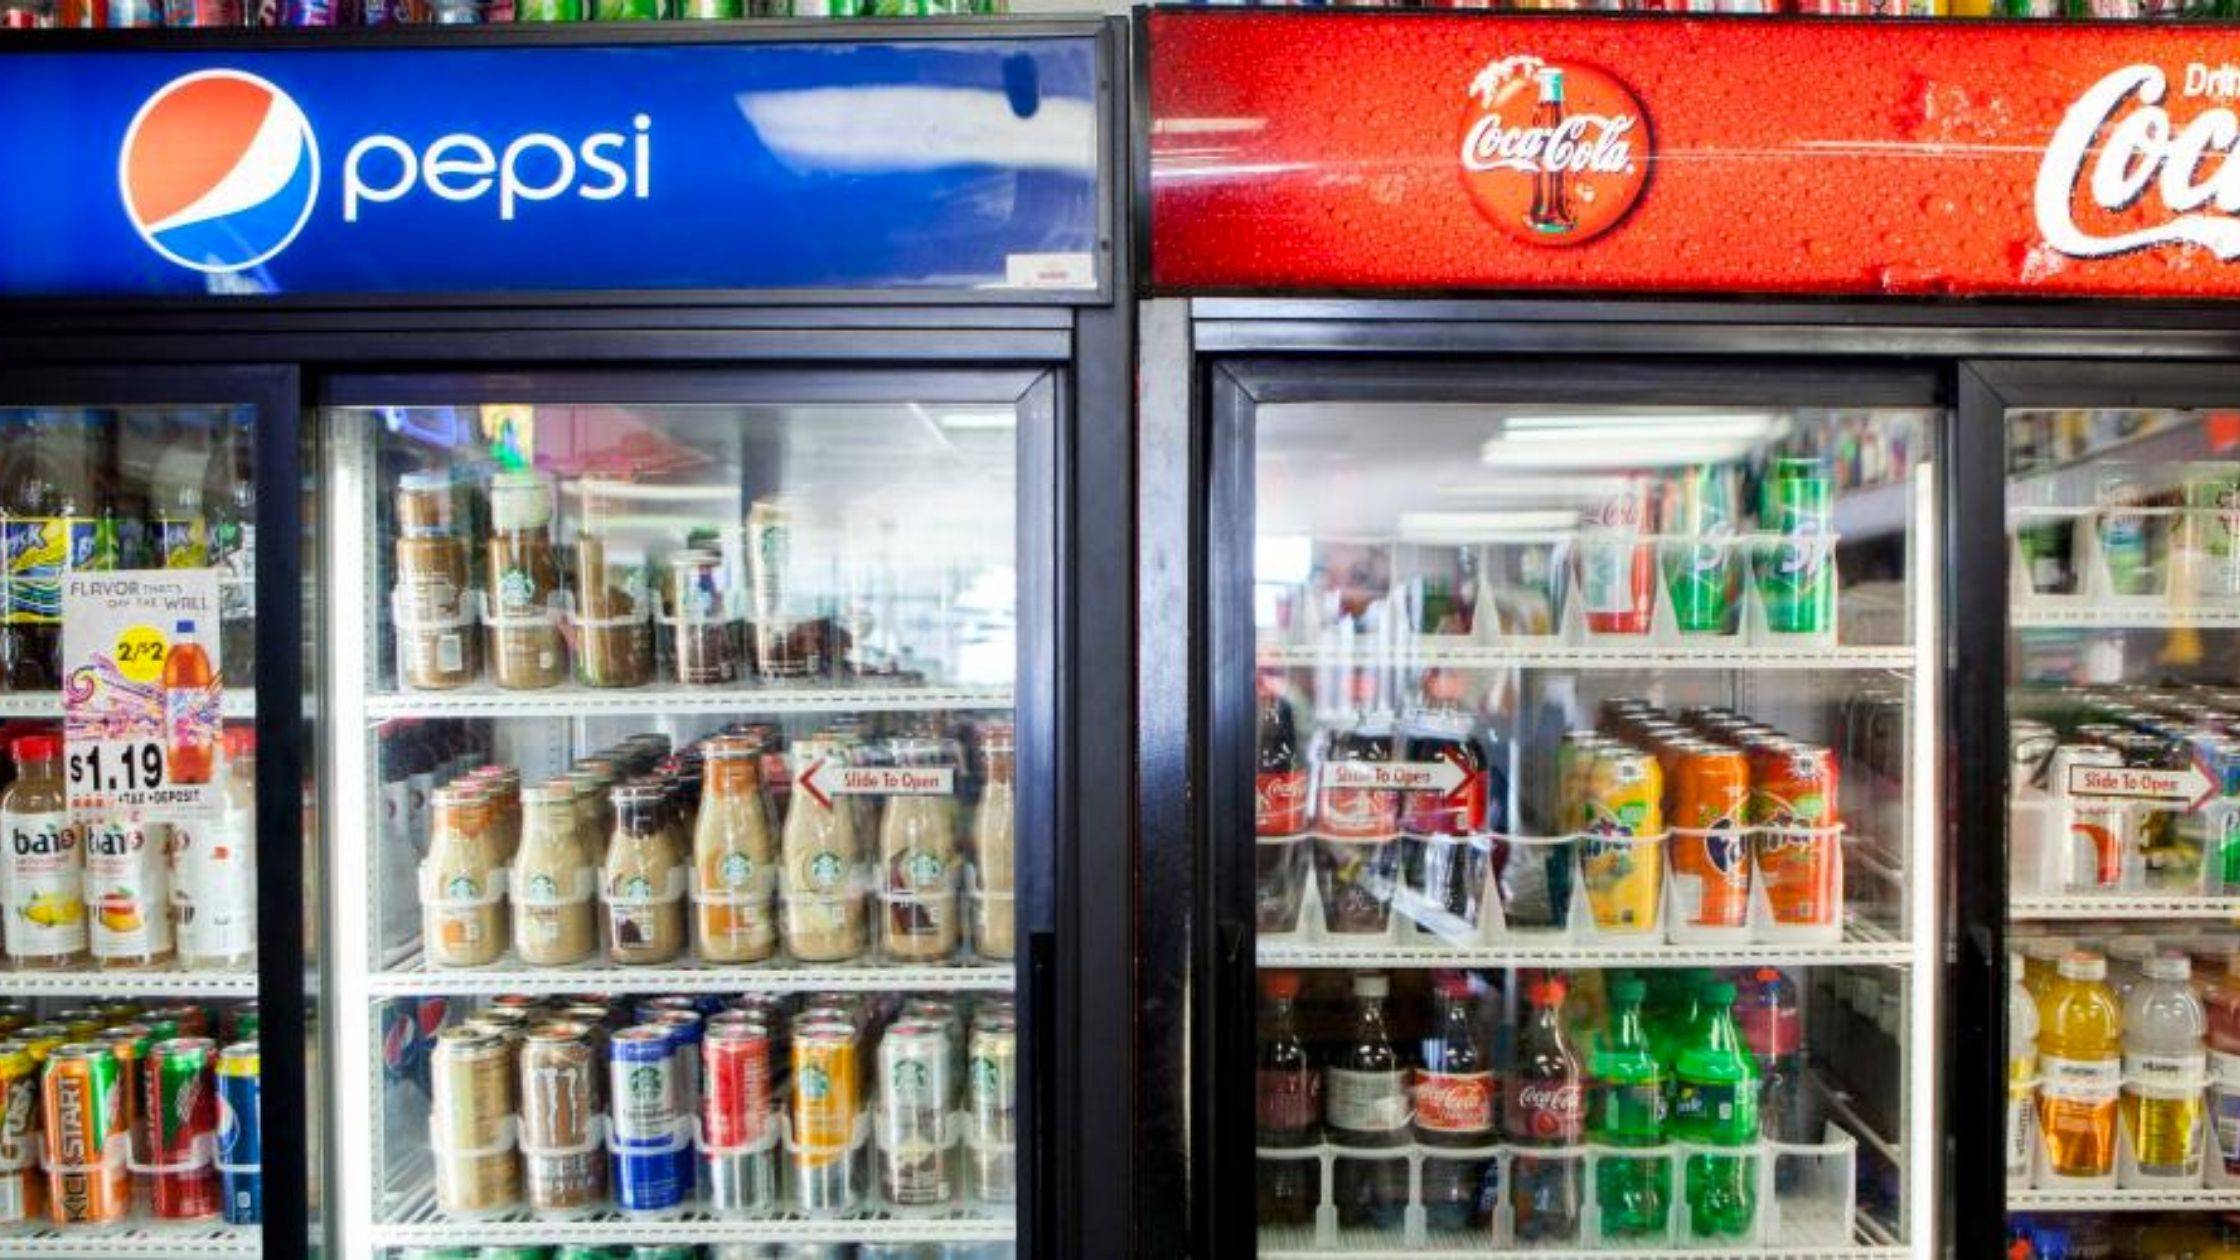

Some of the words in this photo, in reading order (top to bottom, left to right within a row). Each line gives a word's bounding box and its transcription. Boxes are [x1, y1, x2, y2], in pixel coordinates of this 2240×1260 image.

[343, 113, 651, 222] pepsi
[70, 581, 139, 597] FLAVOR
[164, 594, 209, 611] WALL
[70, 743, 163, 790] $1.19
[844, 772, 879, 788] Slide
[884, 772, 898, 788] To
[902, 773, 940, 791] Open
[1375, 767, 1390, 782] To
[1394, 768, 1430, 786] Open
[2084, 772, 2119, 788] Slide
[2123, 774, 2138, 789] To
[2141, 775, 2179, 793] Open
